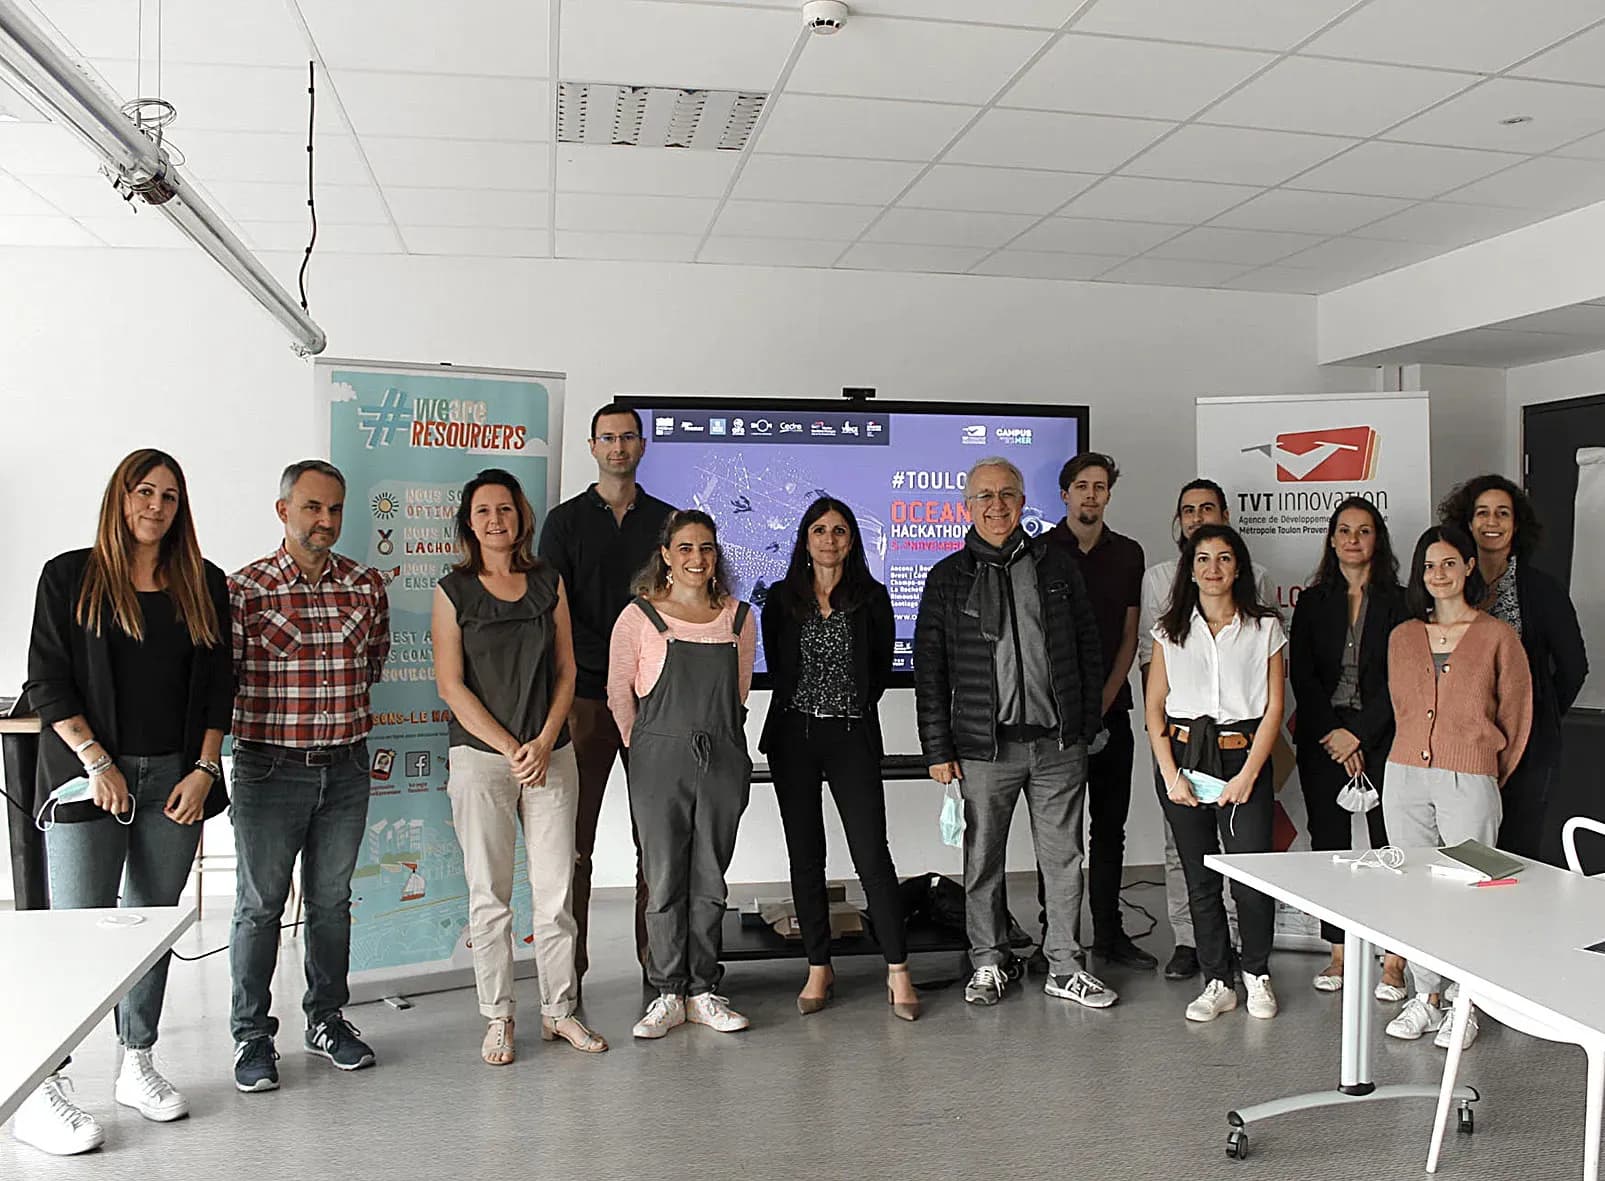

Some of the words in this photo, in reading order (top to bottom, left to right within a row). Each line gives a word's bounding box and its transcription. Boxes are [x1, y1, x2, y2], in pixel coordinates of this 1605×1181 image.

[411, 420, 527, 450] RESOURCERS
[405, 488, 441, 501] NOUS
[1238, 493, 1274, 512] TVT
[891, 500, 972, 523] OCEAN
[1239, 516, 1266, 524] Agence
[891, 524, 970, 538] HACKATHON
[1239, 526, 1276, 535] Métropole
[1278, 526, 1301, 534] Toulon
